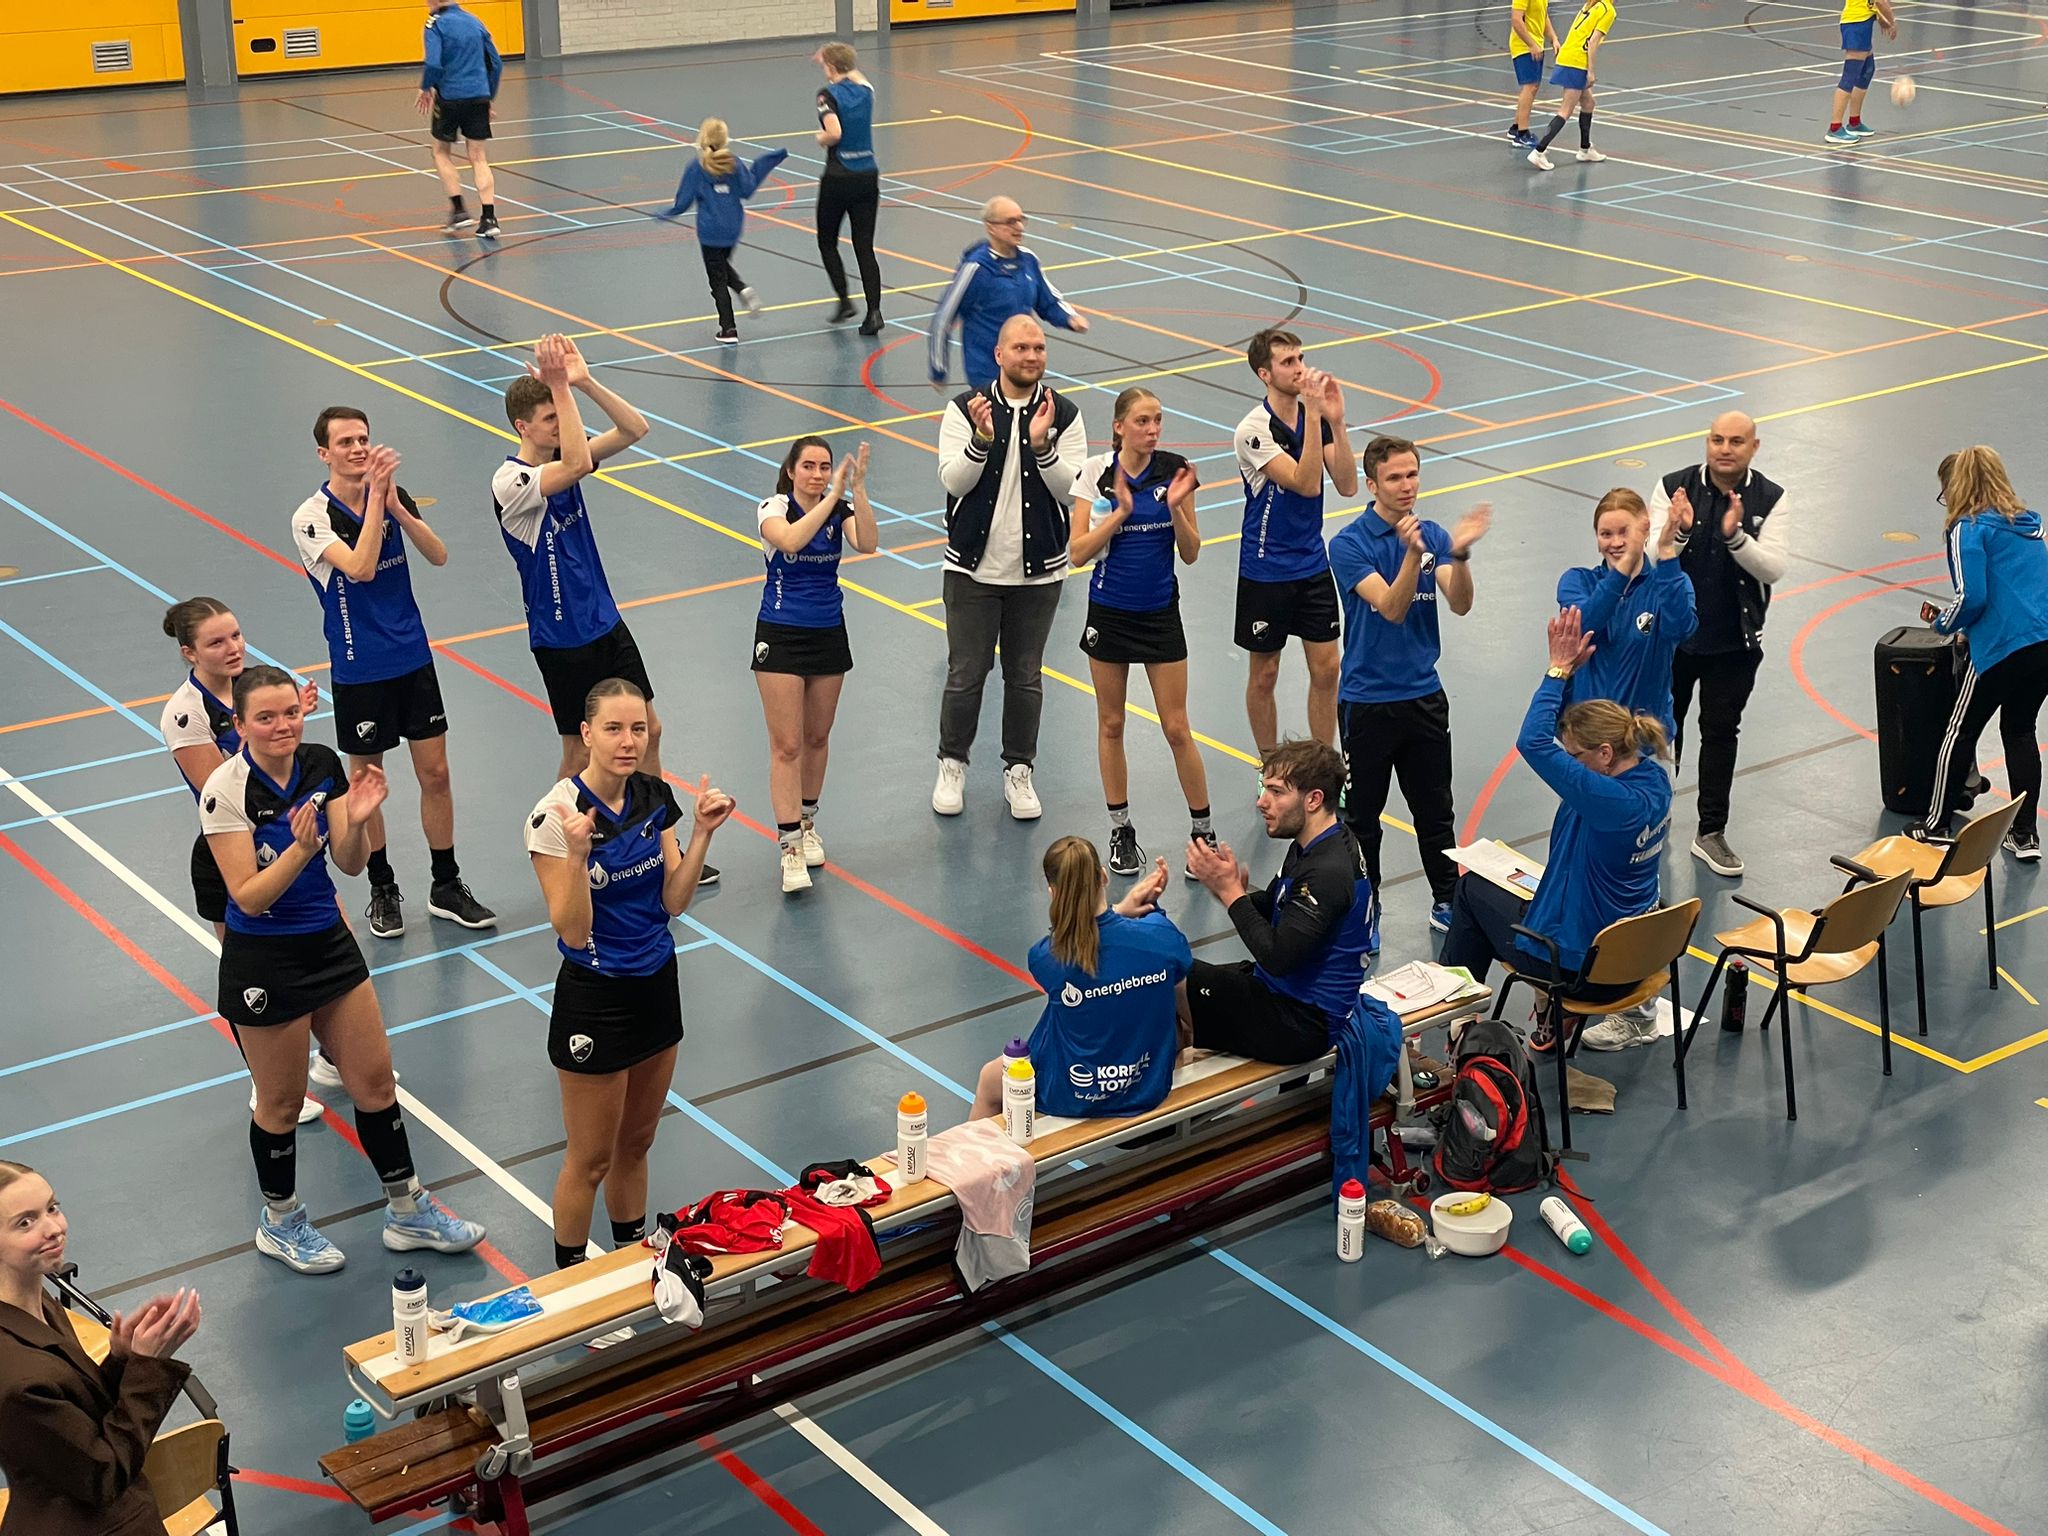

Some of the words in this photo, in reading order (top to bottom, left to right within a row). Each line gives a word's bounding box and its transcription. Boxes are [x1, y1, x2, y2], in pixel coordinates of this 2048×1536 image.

[546, 531, 554, 552] CKV
[336, 576, 345, 595] CKV
[548, 554, 561, 604] REEHORST
[339, 597, 353, 645] REEHORST
[1085, 968, 1167, 999] energiebreed
[907, 1146, 915, 1175] EMPASO
[404, 1326, 413, 1357] EMPASO
